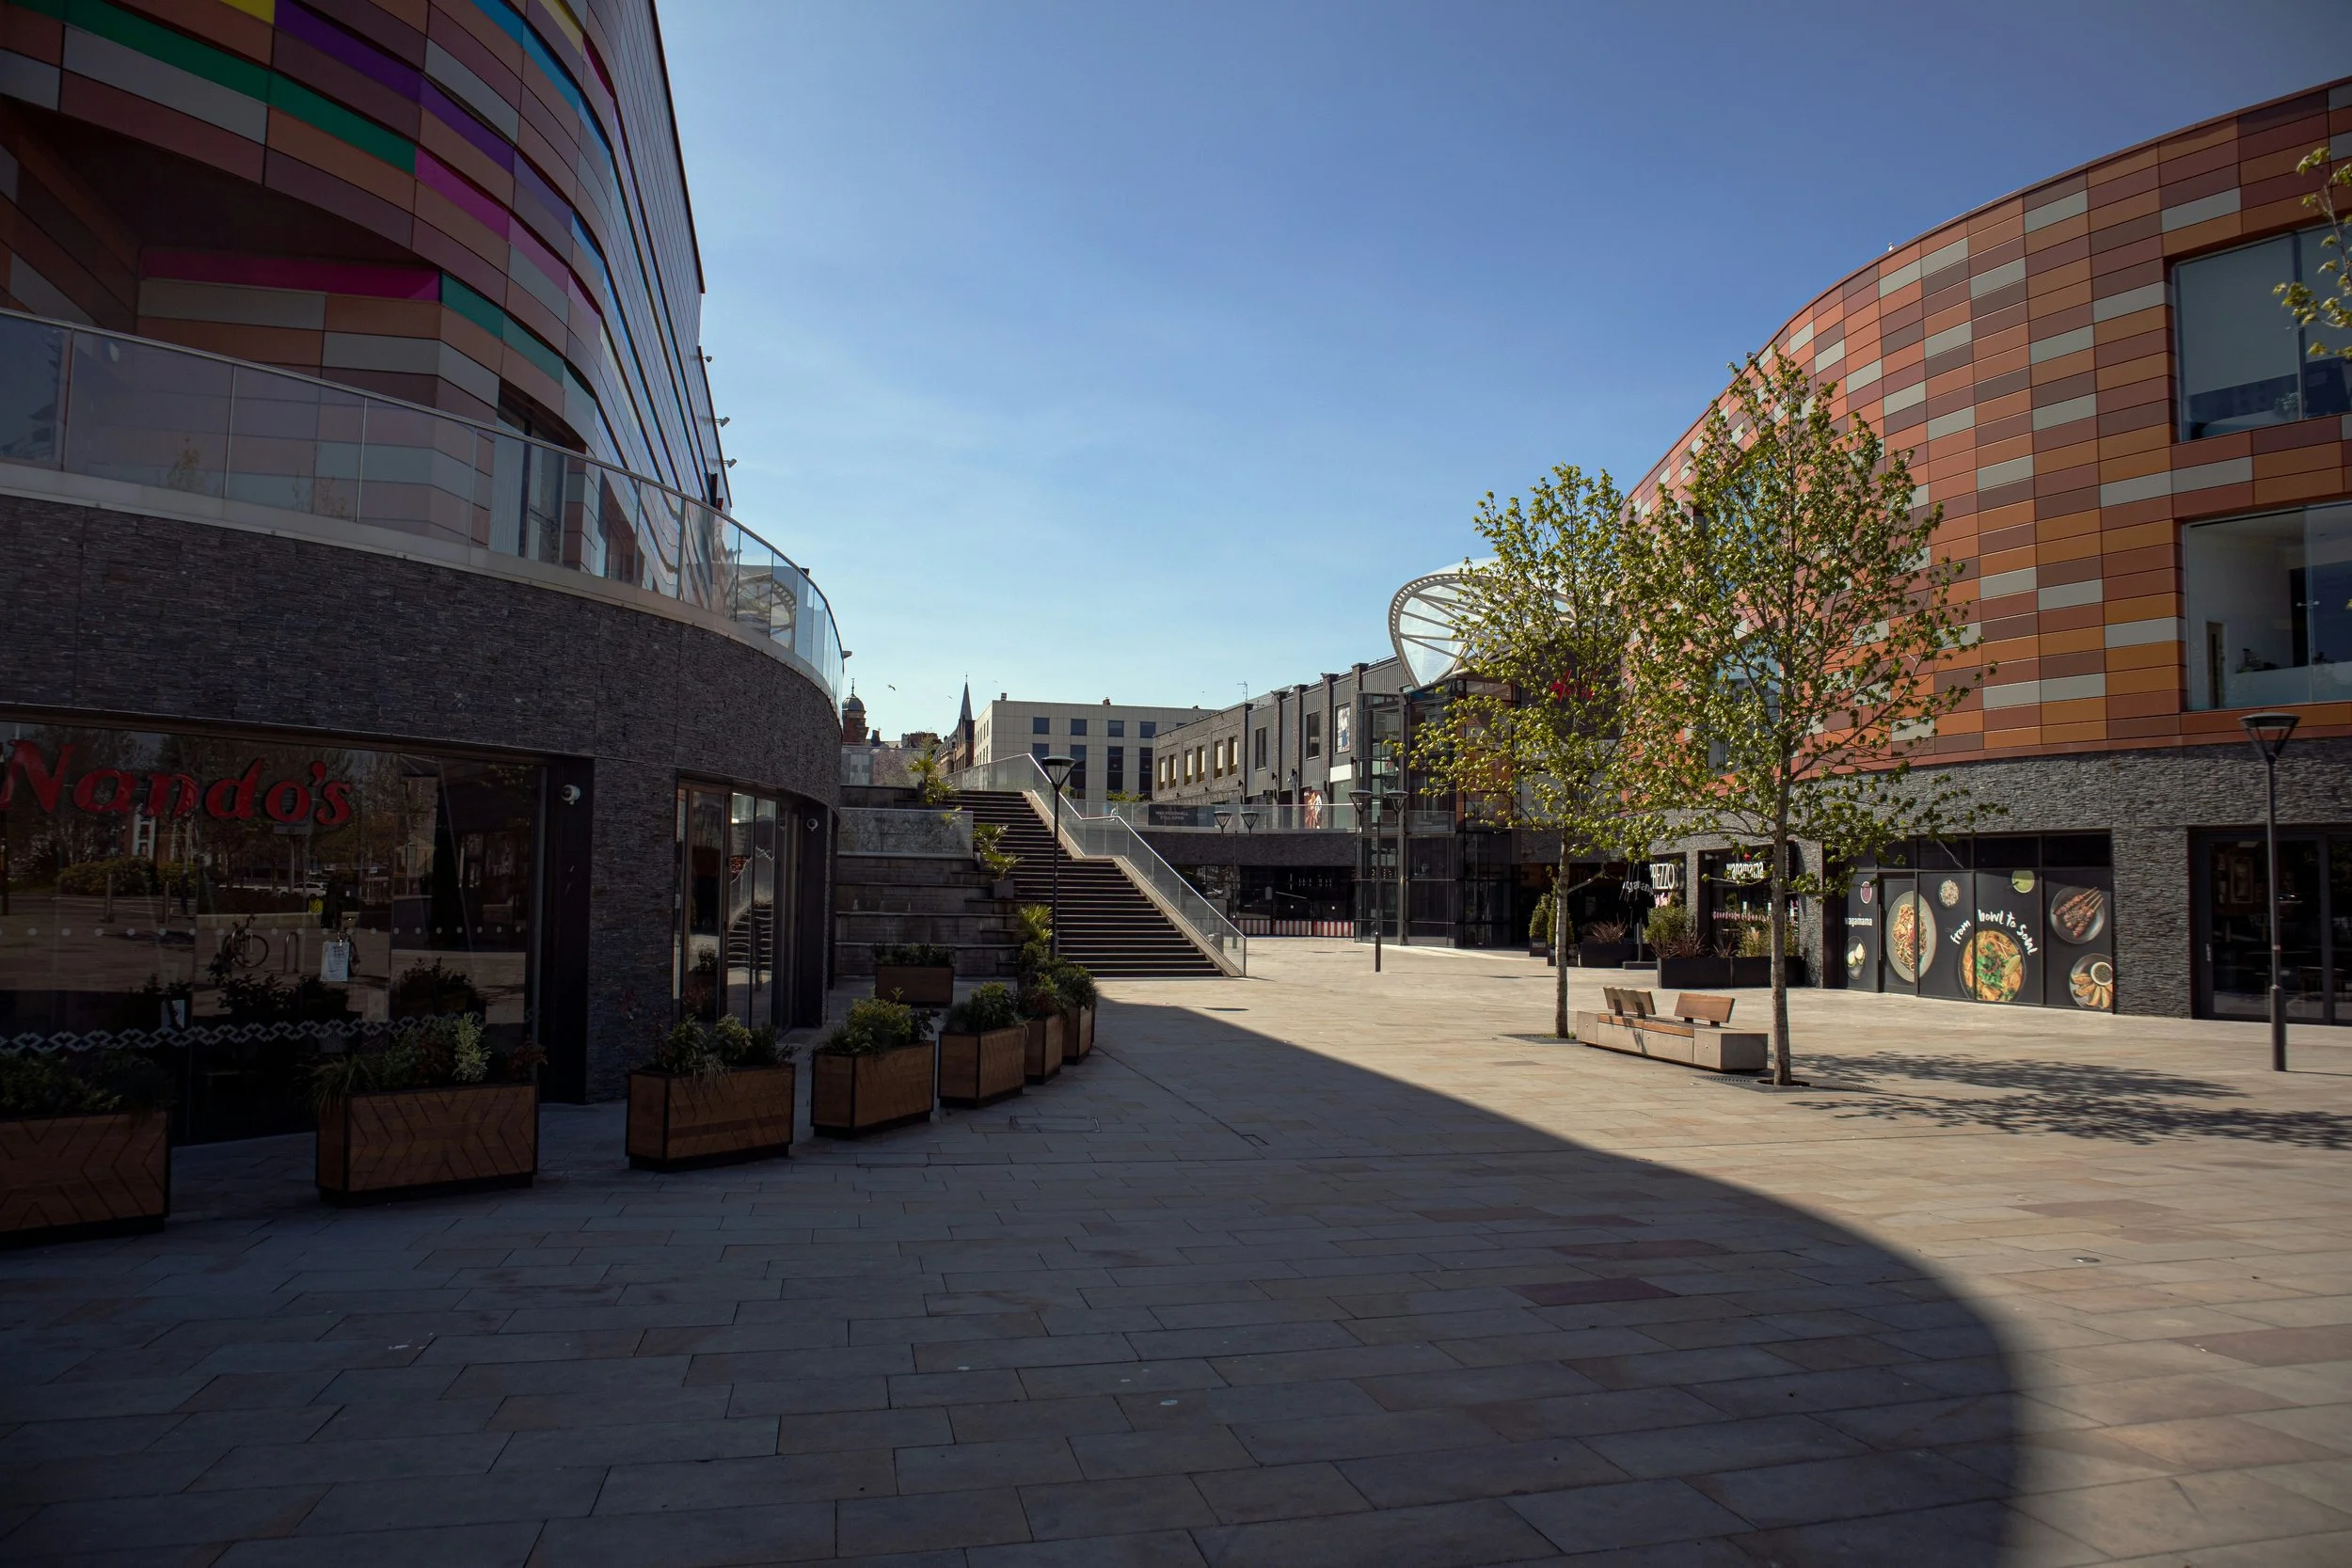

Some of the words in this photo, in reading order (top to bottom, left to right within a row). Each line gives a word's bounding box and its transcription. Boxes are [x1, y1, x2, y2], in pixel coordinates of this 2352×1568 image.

[0, 739, 354, 827] Nando's
[1844, 917, 1873, 927] wagamama
[1949, 920, 1972, 945] from
[1978, 909, 2004, 925] bowl
[2006, 911, 2017, 928] to
